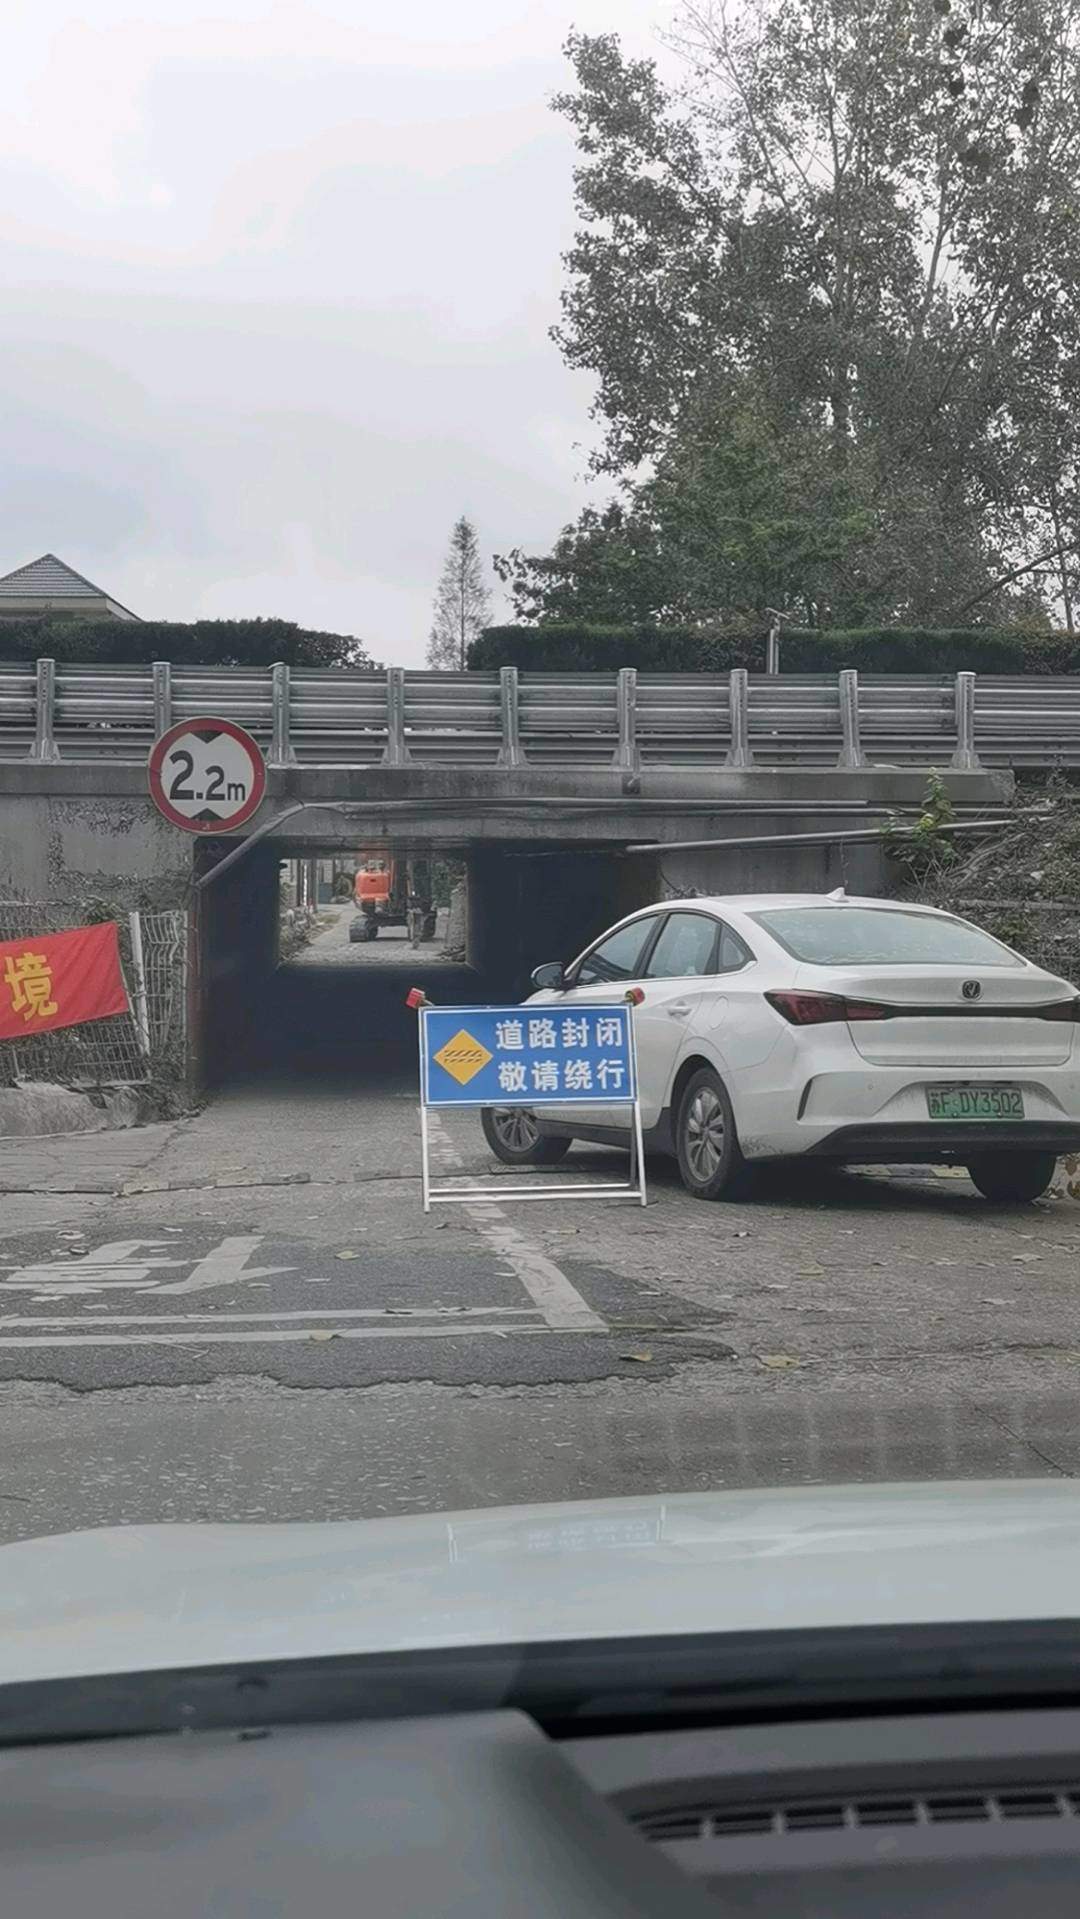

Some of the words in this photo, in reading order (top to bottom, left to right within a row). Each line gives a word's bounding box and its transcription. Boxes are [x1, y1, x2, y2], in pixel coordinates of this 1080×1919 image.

[169, 750, 246, 801] 2.2m
[4, 952, 58, 1021] 境
[496, 1017, 623, 1050] 道路封闭
[498, 1059, 626, 1092] 敬请绕行
